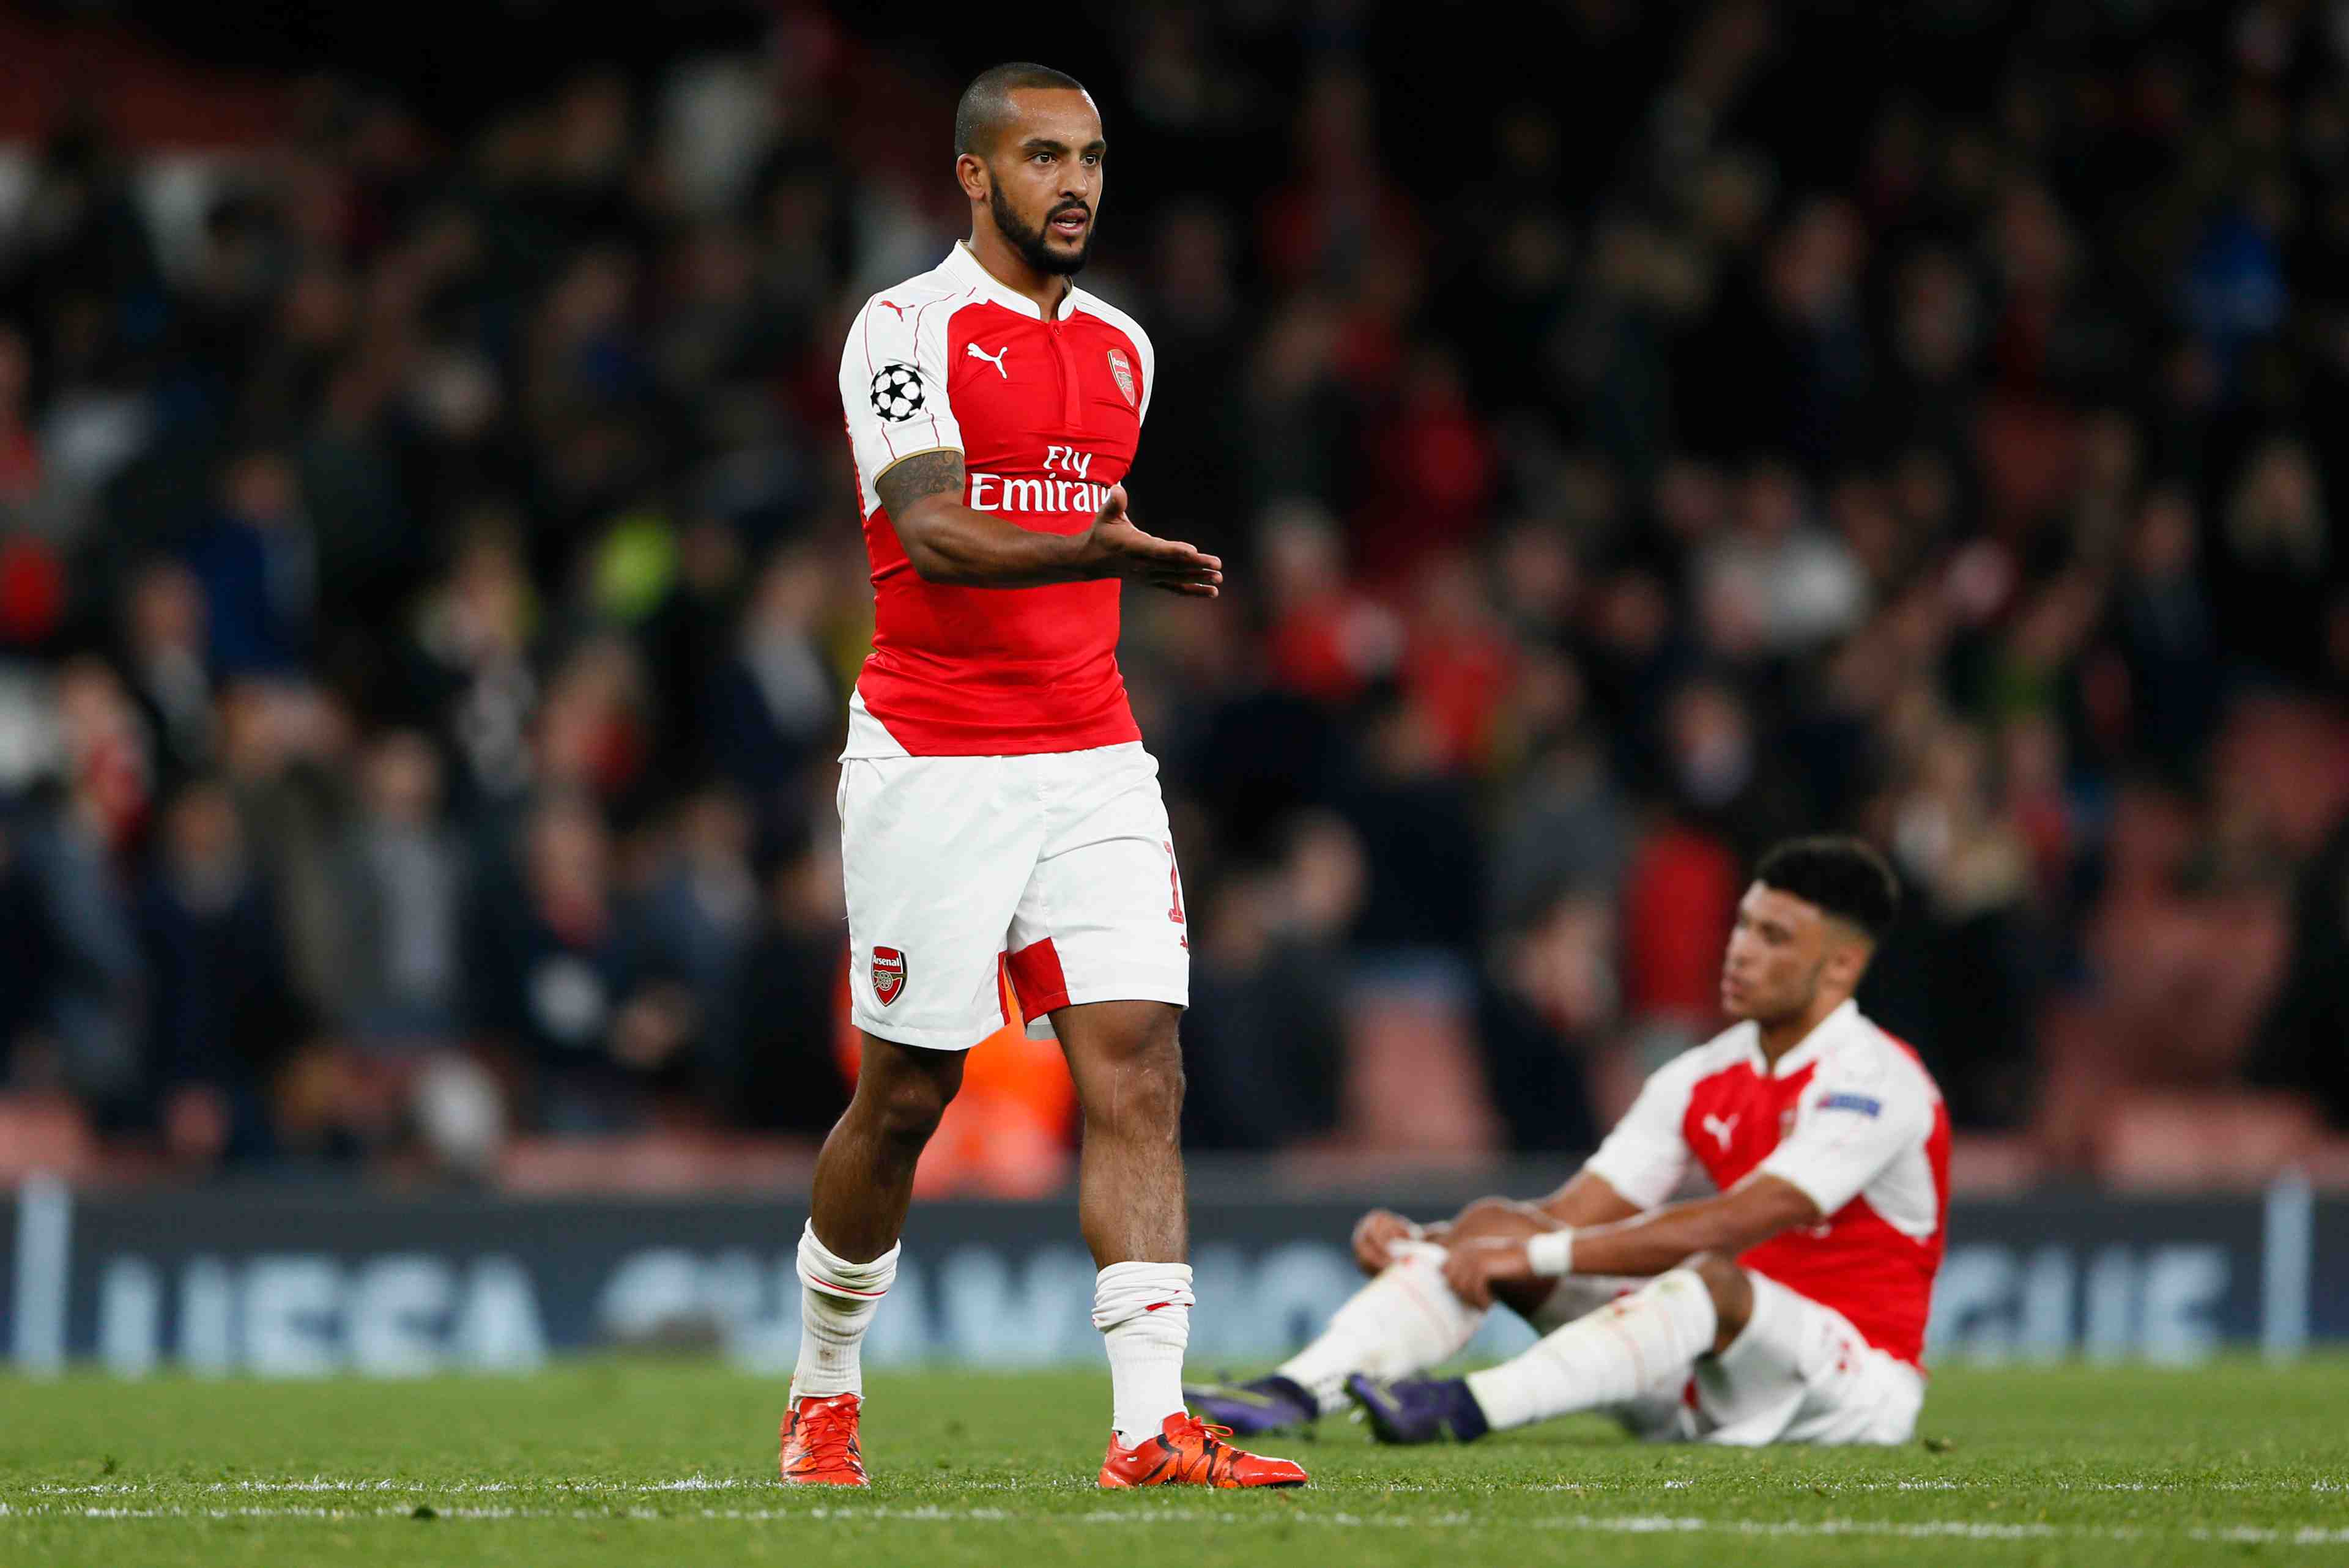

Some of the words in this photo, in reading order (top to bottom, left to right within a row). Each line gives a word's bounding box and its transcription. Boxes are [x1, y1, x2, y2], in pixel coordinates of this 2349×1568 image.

[1043, 446, 1092, 479] Fly
[968, 473, 1111, 512] Emirat
[873, 955, 900, 967] Arsenal
